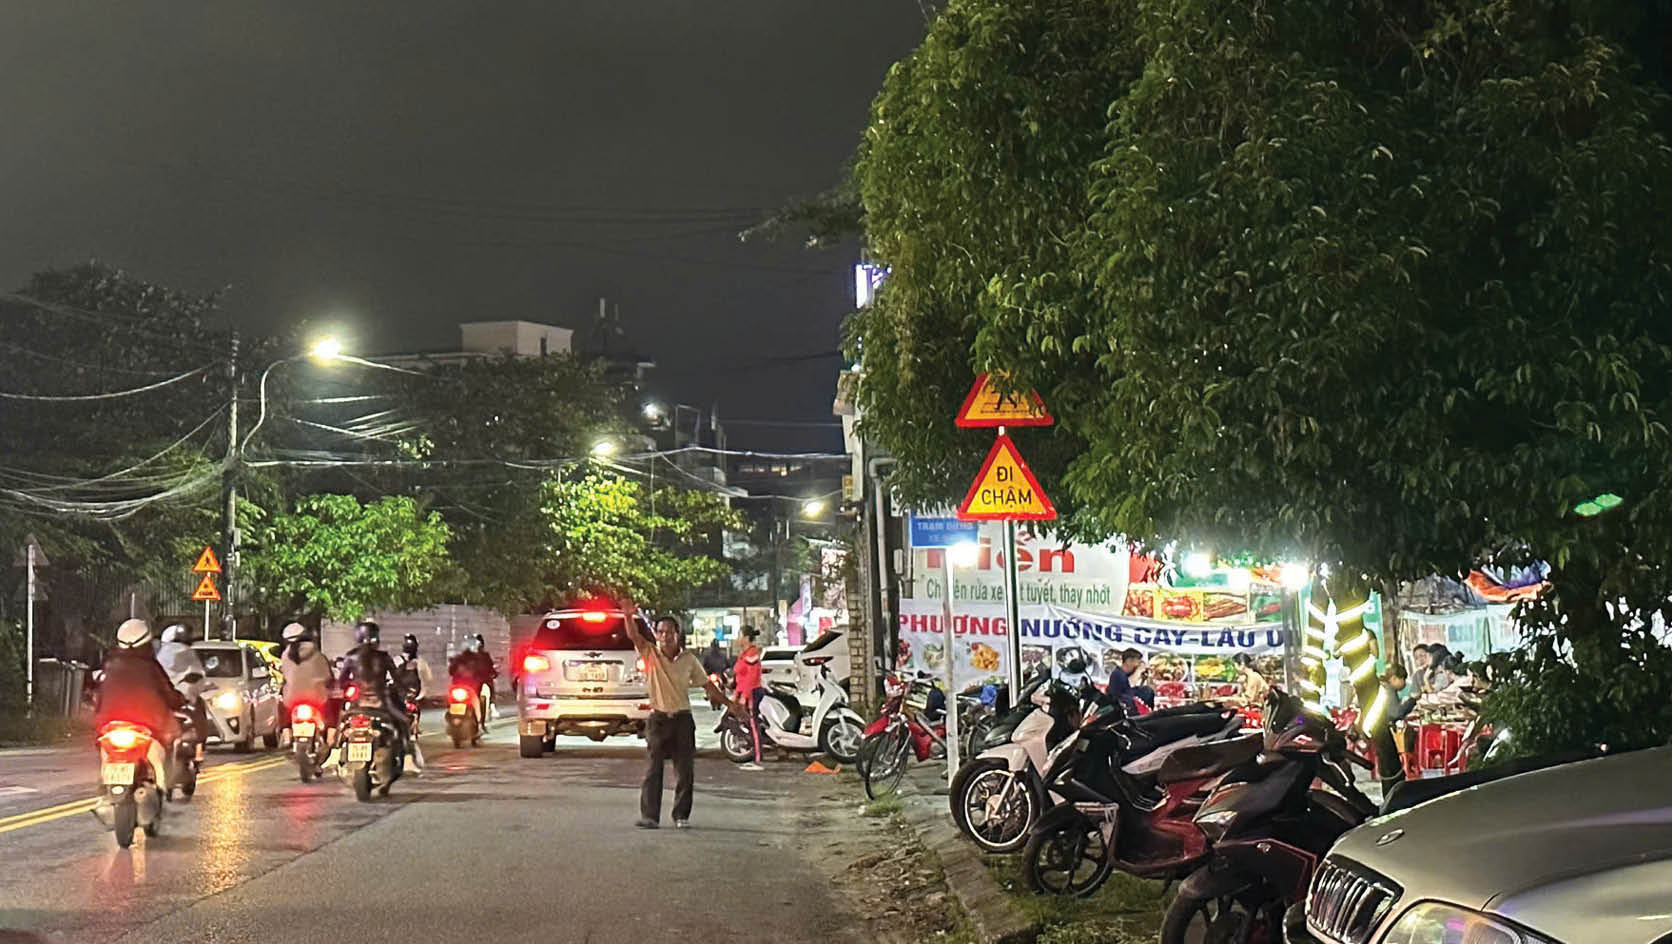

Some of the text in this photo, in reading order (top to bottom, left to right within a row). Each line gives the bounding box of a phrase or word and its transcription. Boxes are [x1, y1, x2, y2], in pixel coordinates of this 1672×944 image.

[996, 466, 1013, 482] ĐI
[981, 486, 1032, 508] CHẬM
[991, 584, 1003, 601] xe
[1060, 583, 1083, 609] thay
